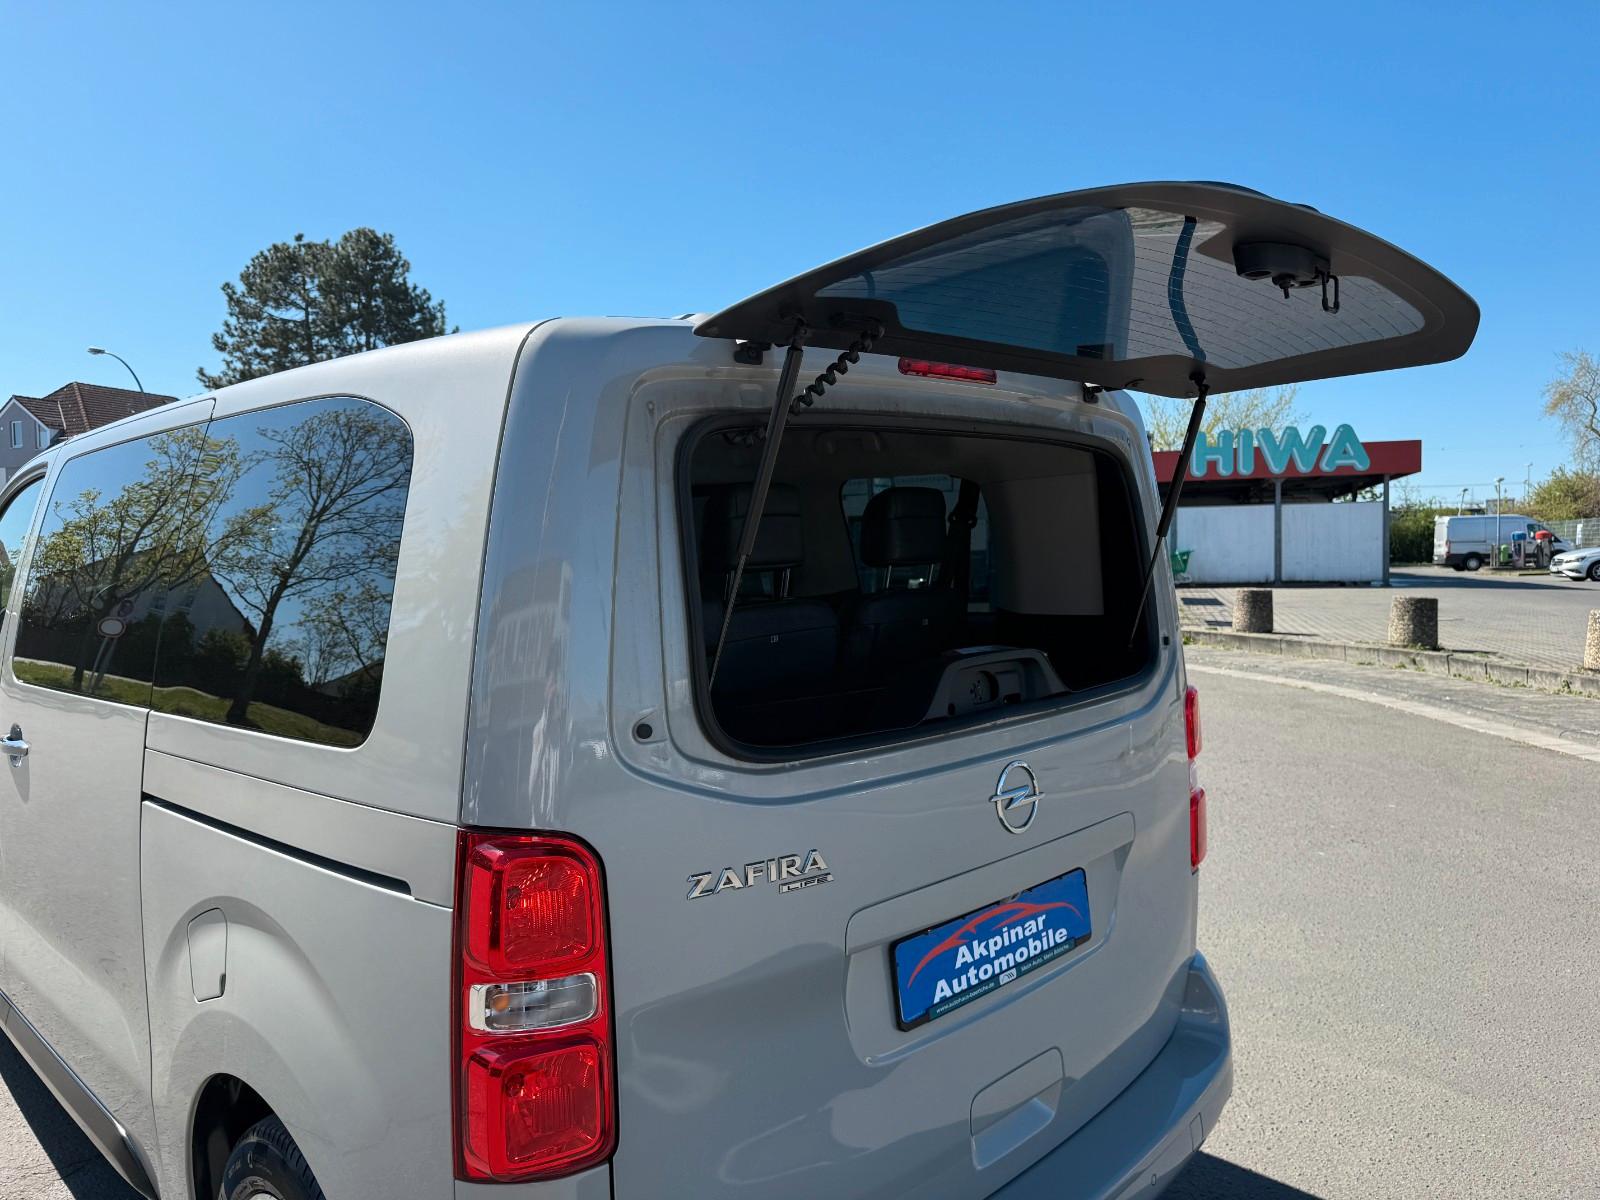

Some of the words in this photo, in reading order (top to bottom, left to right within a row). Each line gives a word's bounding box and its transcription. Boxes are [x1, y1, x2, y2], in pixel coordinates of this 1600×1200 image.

[1190, 424, 1370, 477] HIWA
[687, 849, 829, 900] ZAFIRA
[933, 926, 1067, 1004] Automobile
[955, 914, 1046, 969] Akpinar
